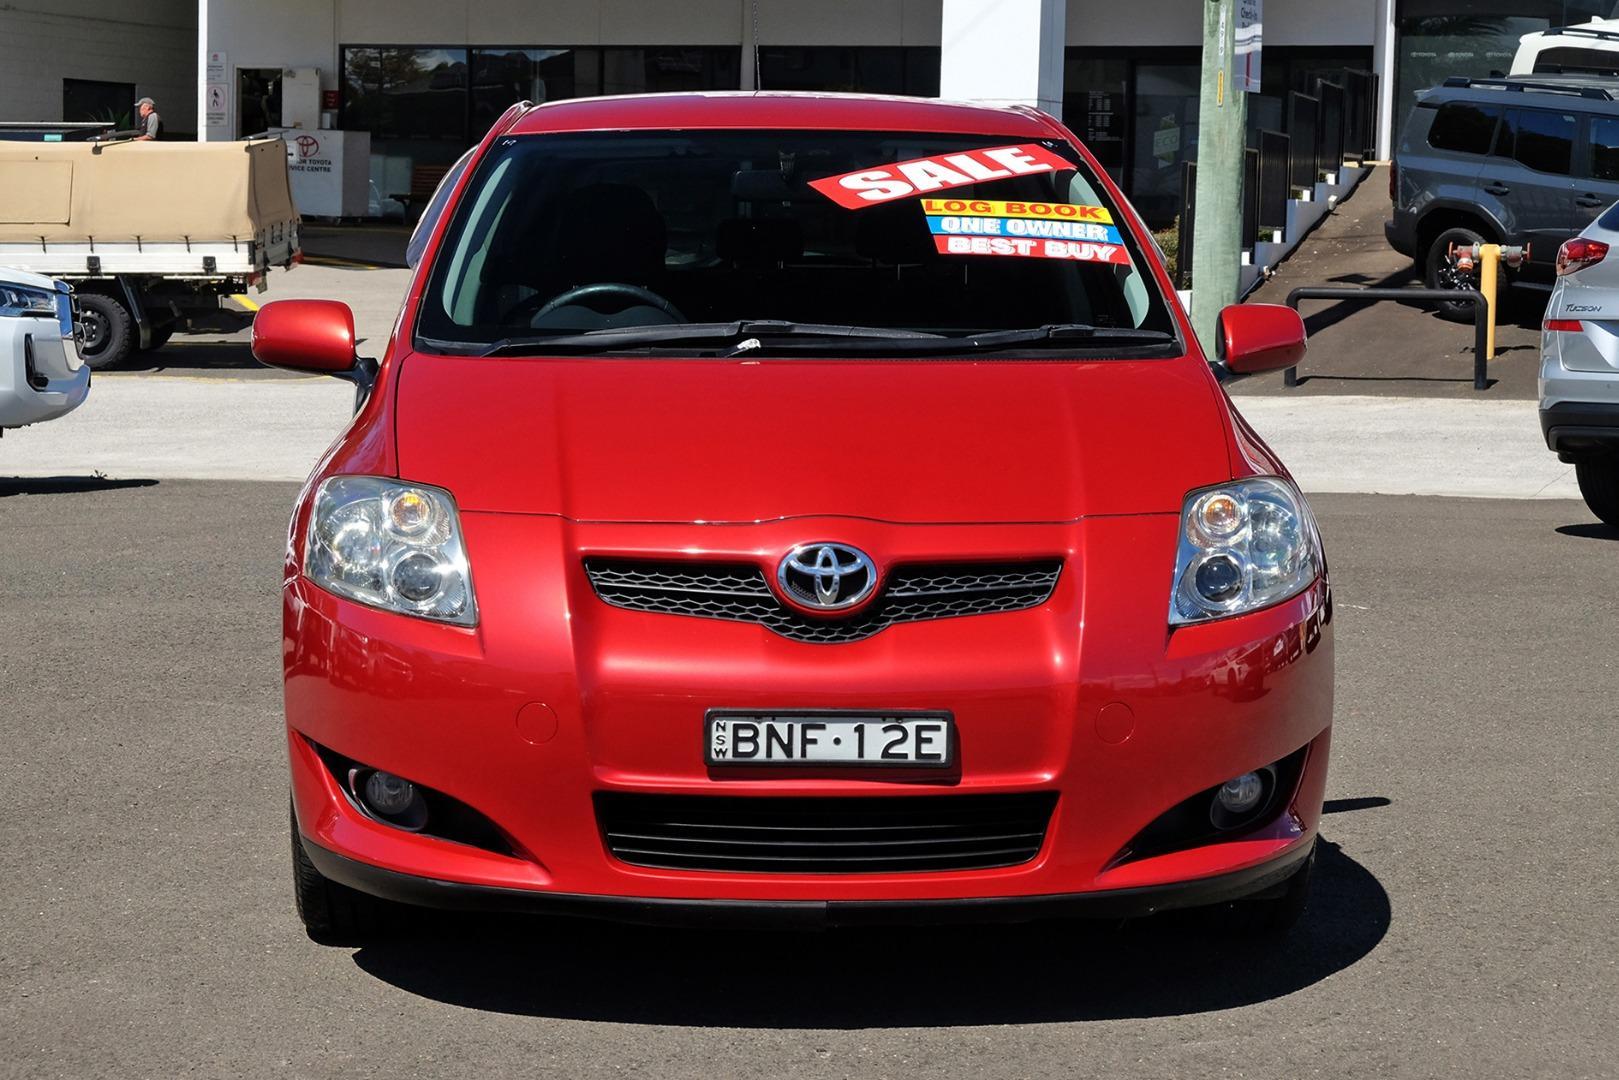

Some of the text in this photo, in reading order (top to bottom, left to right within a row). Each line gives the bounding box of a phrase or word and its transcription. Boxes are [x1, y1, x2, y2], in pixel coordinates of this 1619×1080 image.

[839, 147, 1054, 201] SALE
[925, 200, 1103, 219] LOG BOOK
[941, 216, 1108, 241] ONE OWNER
[947, 236, 1117, 262] BEST BUY
[1565, 303, 1602, 313] TUCSON
